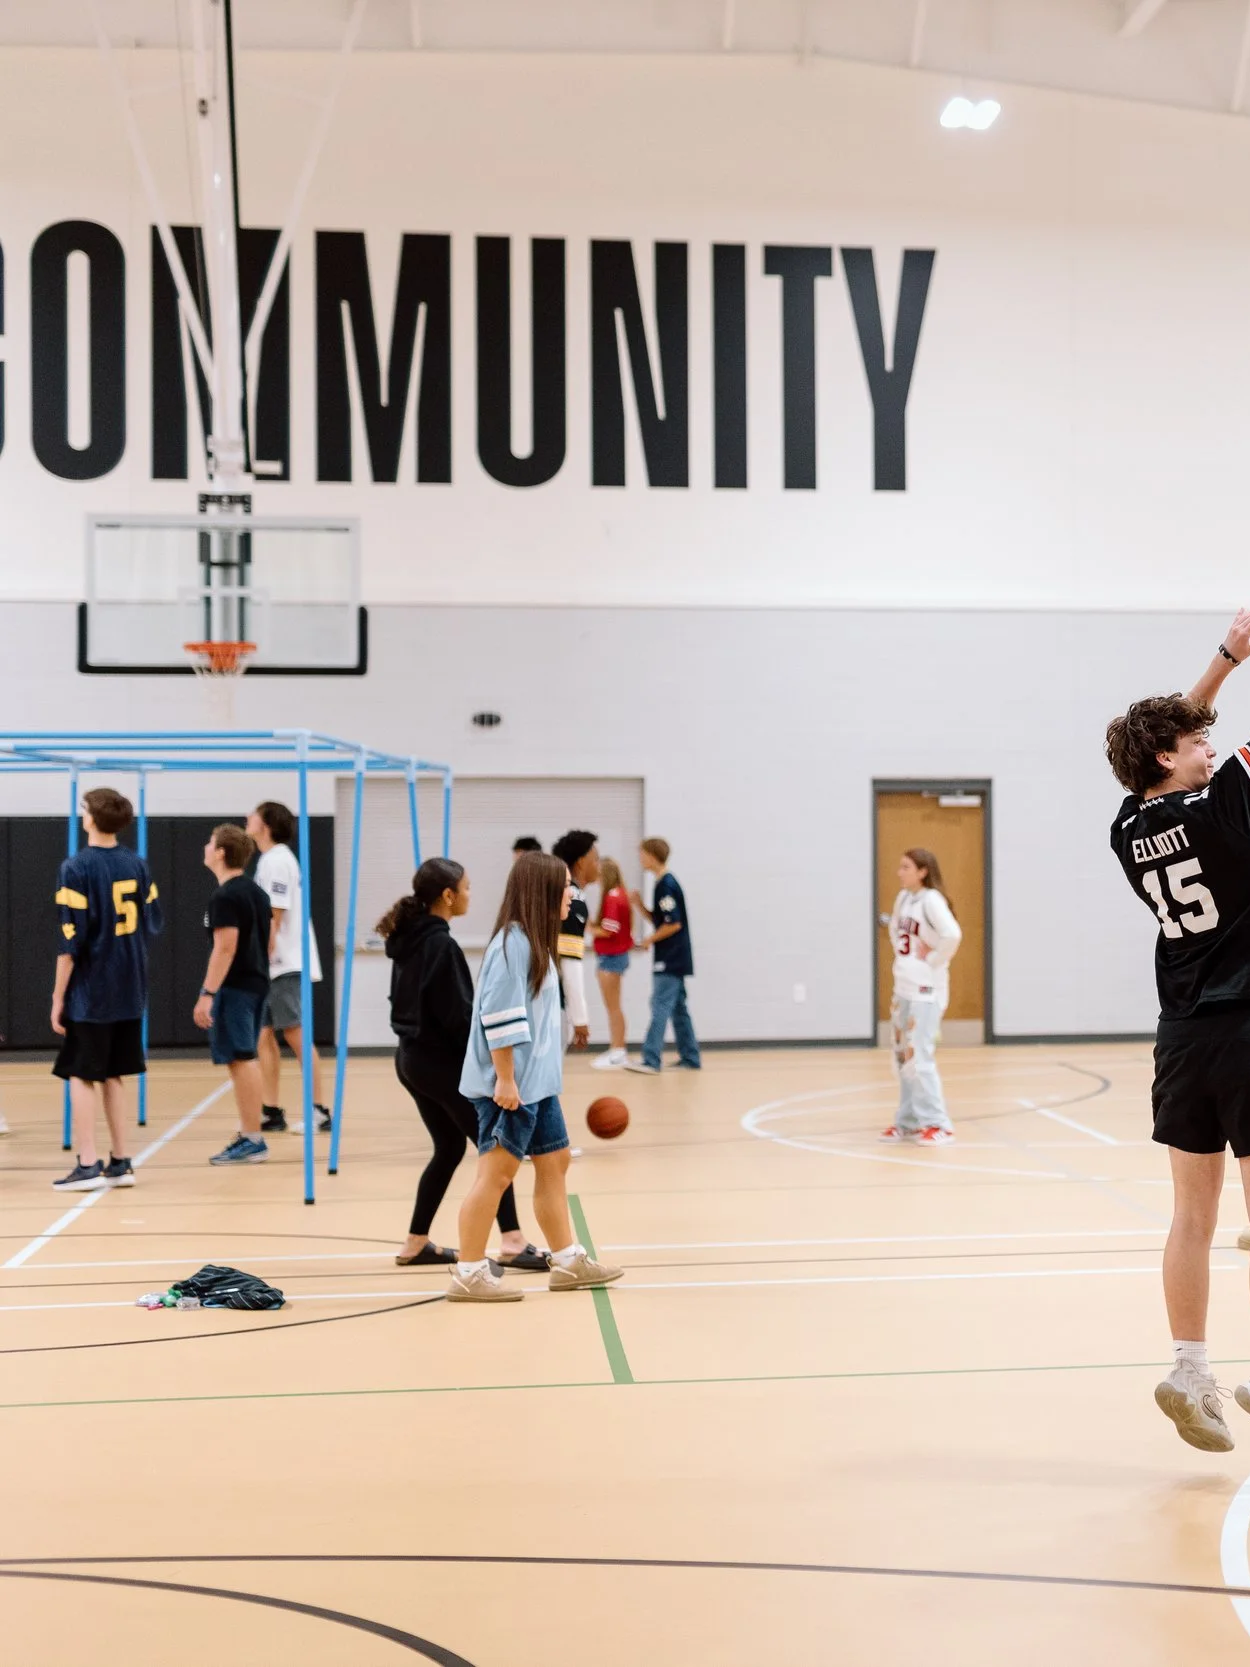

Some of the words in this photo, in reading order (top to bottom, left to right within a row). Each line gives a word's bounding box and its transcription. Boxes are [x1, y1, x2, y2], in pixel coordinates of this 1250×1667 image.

[0, 220, 936, 490] OMMUNITY
[1131, 824, 1191, 864] ELLIOTT
[112, 879, 138, 937] 5
[1142, 857, 1220, 939] 15
